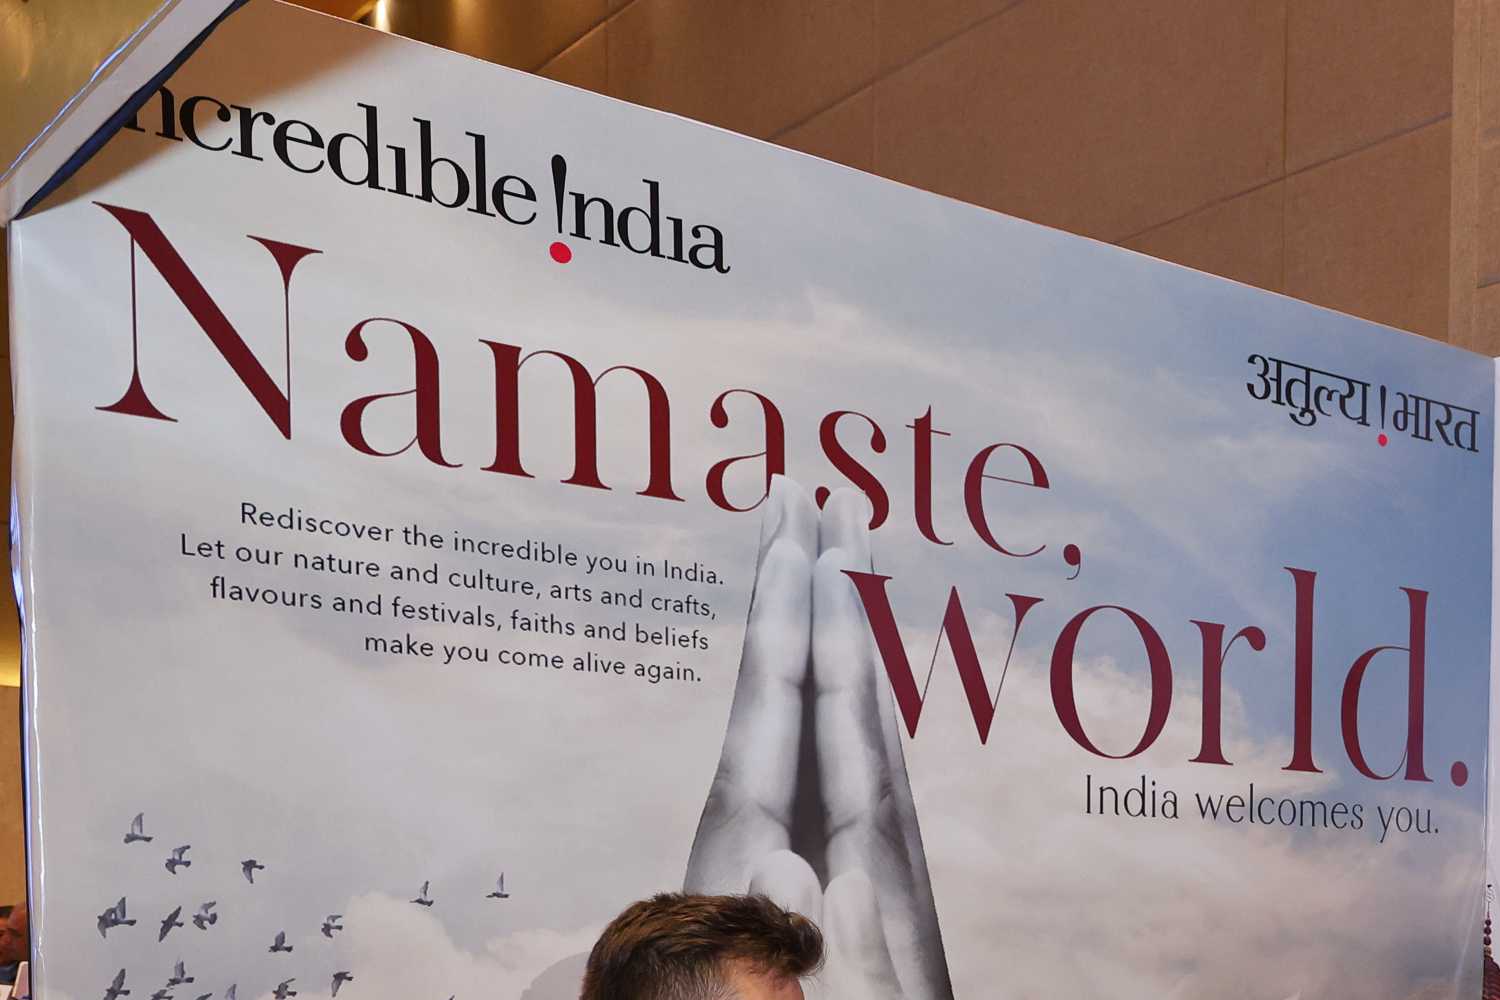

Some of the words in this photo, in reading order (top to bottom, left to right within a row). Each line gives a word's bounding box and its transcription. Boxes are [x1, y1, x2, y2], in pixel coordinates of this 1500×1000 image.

[124, 86, 537, 226] ncredible
[92, 201, 1081, 580] Namaste,
[181, 533, 225, 559] Let
[236, 547, 283, 565] our
[294, 553, 380, 577] nature
[390, 563, 439, 584] and
[448, 569, 541, 599] culture,
[550, 583, 592, 602] arts
[600, 589, 643, 609] and
[651, 595, 717, 620] crafts,
[241, 502, 394, 542] Rediscover
[403, 525, 444, 549] the
[454, 531, 578, 566] incredible
[586, 554, 627, 574] you
[636, 556, 655, 576] in
[664, 559, 724, 585] India.
[210, 576, 322, 609] flavours
[332, 594, 382, 616] and
[392, 596, 502, 631] festivals,
[510, 609, 575, 636] faiths
[584, 621, 626, 641] and
[635, 624, 709, 650] beliefs
[365, 633, 434, 657] make
[443, 645, 488, 664] you
[498, 649, 564, 669] come
[573, 652, 626, 675] alive
[634, 661, 702, 683] again.
[1086, 774, 1180, 819] India
[1195, 783, 1364, 830] welcomes
[1377, 806, 1439, 843] you.
